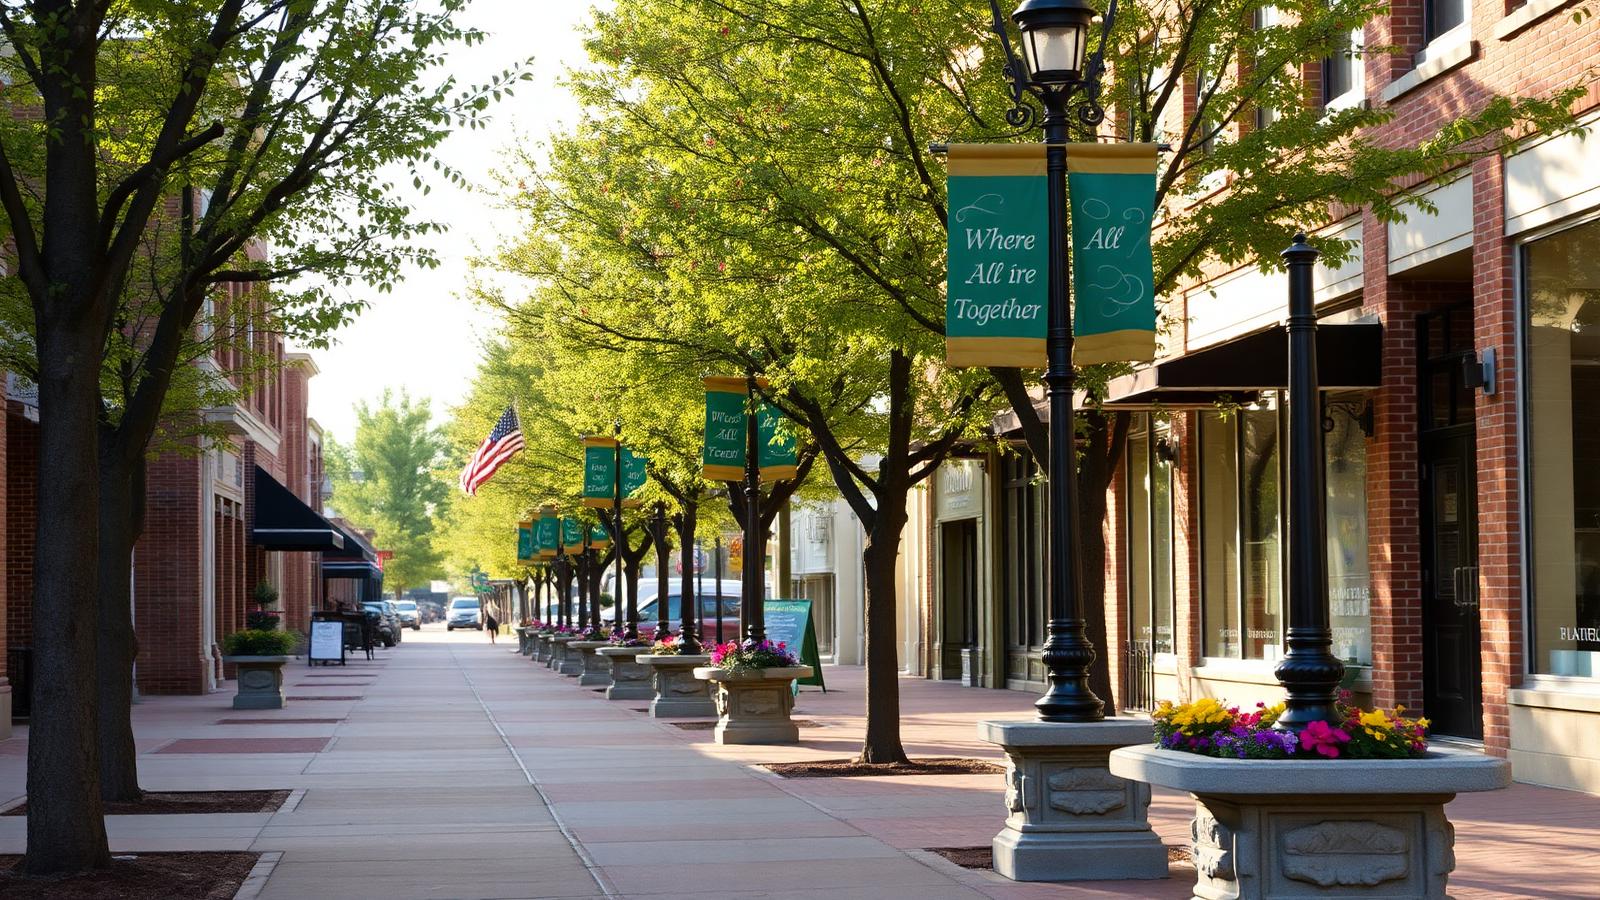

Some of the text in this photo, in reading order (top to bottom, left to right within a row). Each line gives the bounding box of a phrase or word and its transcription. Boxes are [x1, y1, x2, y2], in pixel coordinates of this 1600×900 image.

[965, 227, 1036, 250] Where
[1082, 226, 1125, 250] All
[965, 262, 1004, 285] All
[954, 297, 1042, 326] Together
